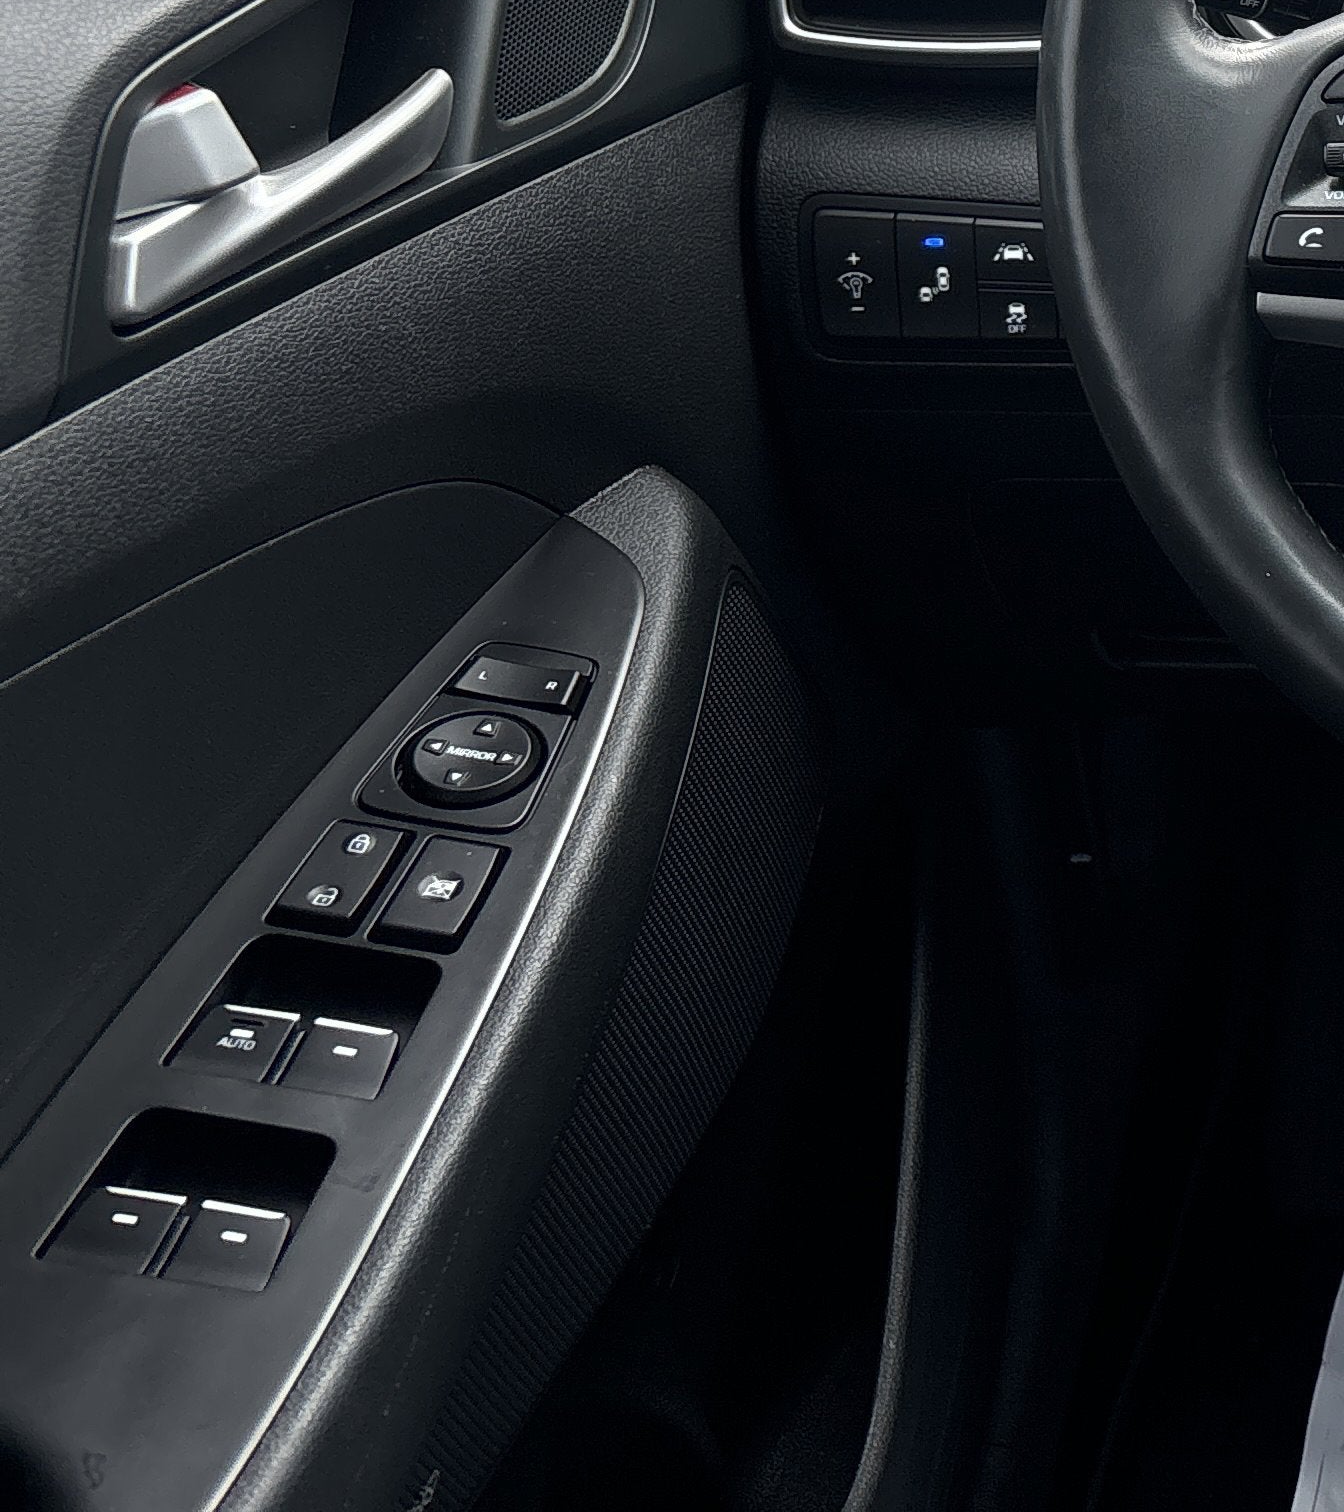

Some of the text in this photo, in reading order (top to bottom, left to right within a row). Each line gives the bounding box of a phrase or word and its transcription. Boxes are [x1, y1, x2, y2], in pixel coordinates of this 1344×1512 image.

[1008, 324, 1026, 334] OFF
[478, 670, 488, 681] L
[545, 681, 557, 691] R
[446, 744, 497, 762] MIRROR
[217, 1037, 256, 1052] AUTO
